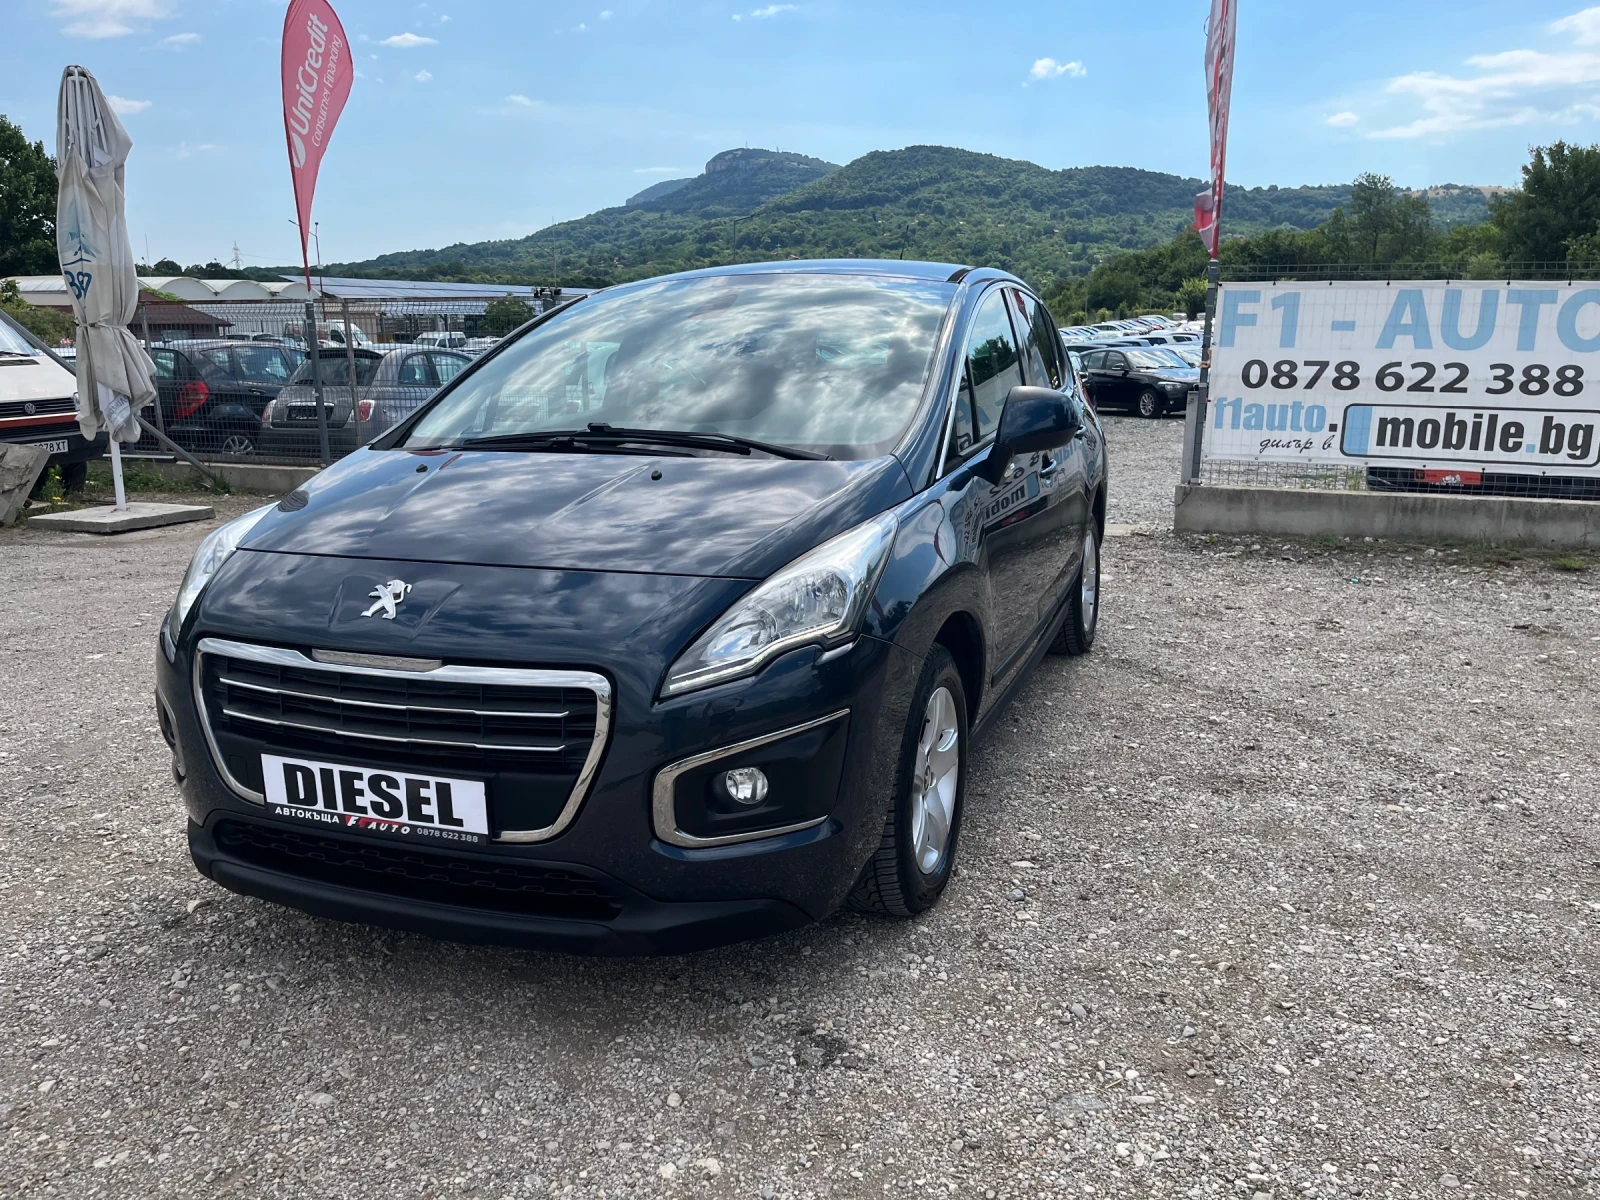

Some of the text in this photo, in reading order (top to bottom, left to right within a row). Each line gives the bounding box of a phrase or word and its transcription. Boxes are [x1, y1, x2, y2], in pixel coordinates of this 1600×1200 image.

[290, 13, 328, 135] UniCredit
[312, 34, 343, 147] Consumer Financing
[1219, 290, 1301, 348] F1
[1375, 288, 1600, 353] AUTO
[1241, 359, 1584, 397] 0878 622 388
[1260, 437, 1314, 453] дилър
[1376, 412, 1594, 460] mobile.bg
[282, 762, 464, 828] DIESEL
[275, 806, 340, 824] АВТОКЪЩА
[367, 821, 410, 834] AUTO
[416, 828, 440, 837] 0878
[442, 831, 459, 840] 622
[460, 833, 479, 843] 388
